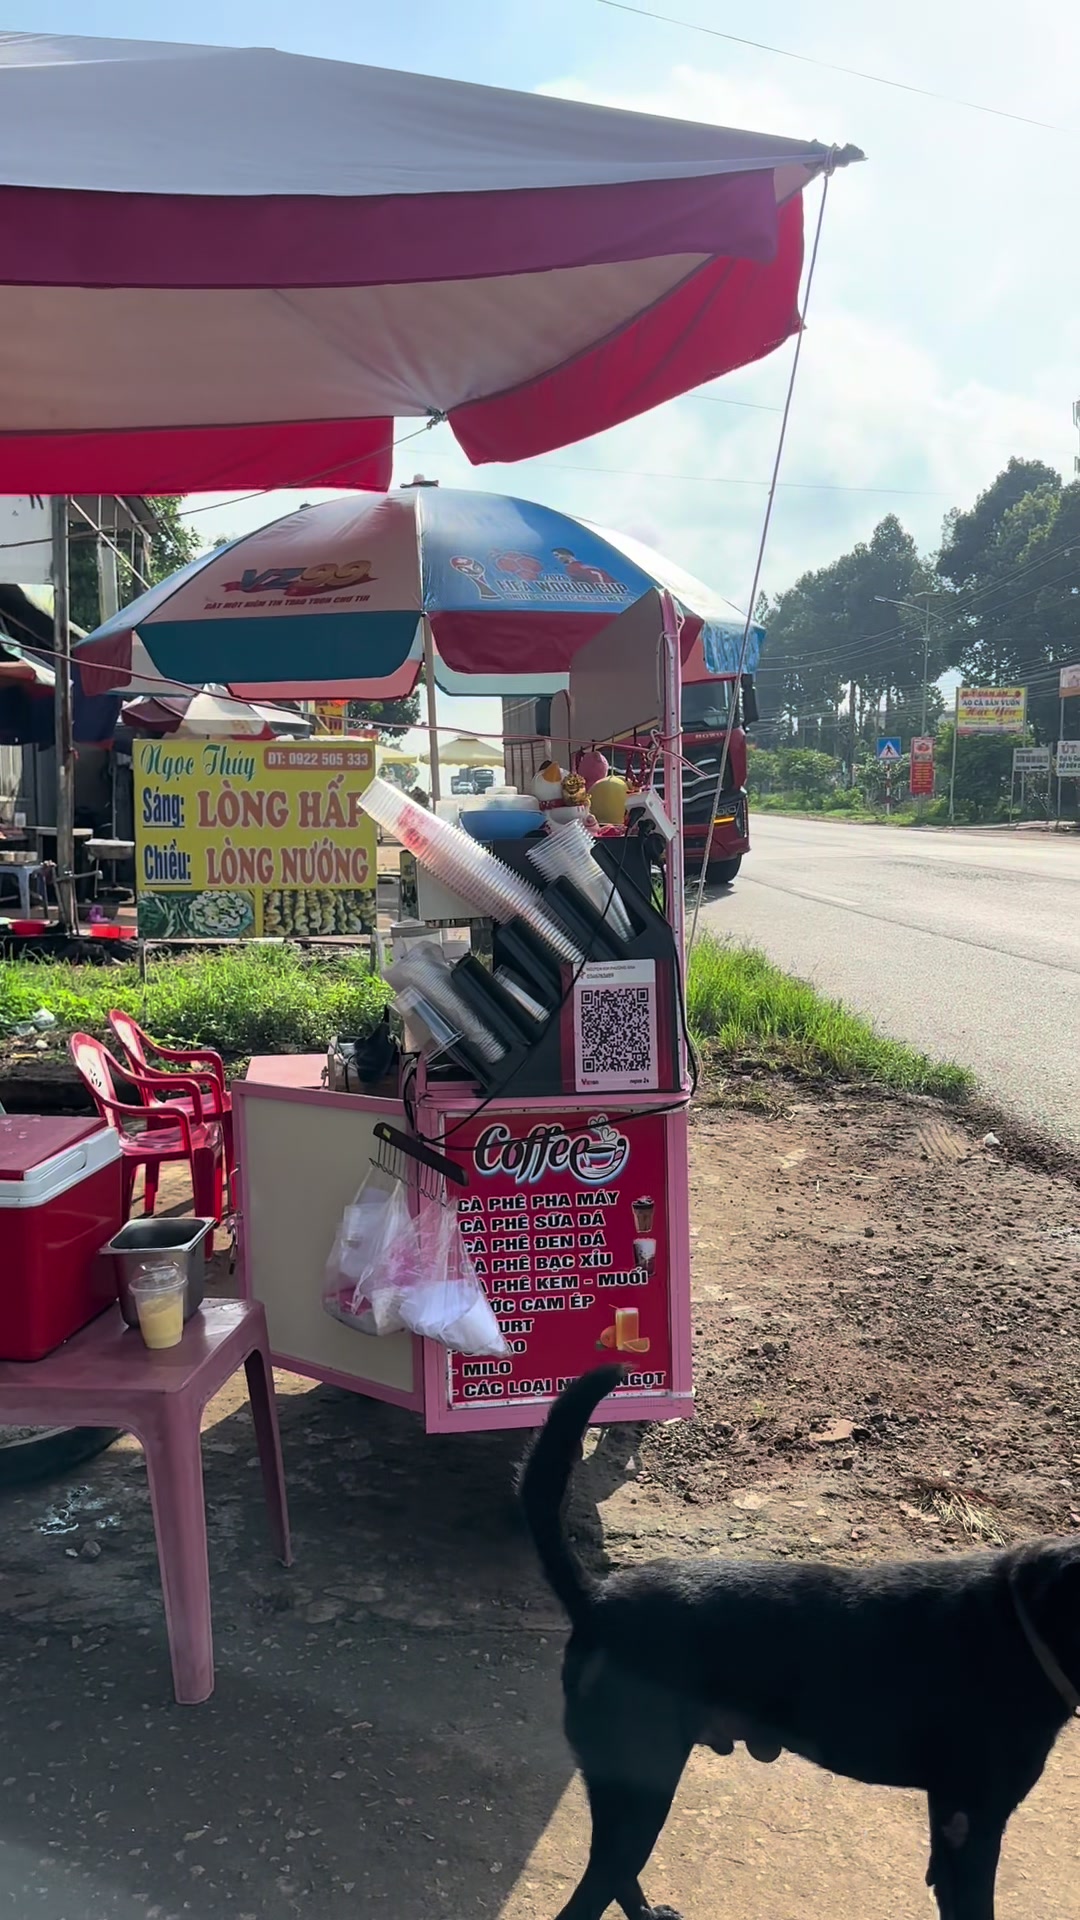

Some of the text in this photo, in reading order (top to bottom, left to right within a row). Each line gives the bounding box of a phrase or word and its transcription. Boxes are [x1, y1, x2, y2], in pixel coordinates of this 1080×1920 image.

[240, 560, 372, 590] VZ99
[535, 581, 594, 595] WORLD
[594, 583, 628, 594] CUP
[140, 743, 256, 781] Ngọc Thúy
[268, 752, 369, 765] ĐT: 0922 505 333
[143, 787, 185, 827] Sáng:
[197, 779, 290, 829] LÒNG
[298, 773, 366, 829] HẤP
[144, 836, 370, 886] Chiều: LÒNG NƯỚNG
[474, 1121, 629, 1185] Coffee
[458, 1189, 619, 1213] CÀ PHÊ PHA MÁY
[460, 1210, 606, 1233] CÀ PHÊ SỮA ĐÁ
[491, 1234, 529, 1251] PHÊ
[535, 1234, 573, 1250] ĐEN
[579, 1230, 606, 1247] ĐÁ
[492, 1254, 530, 1272] PHÊ
[536, 1254, 575, 1272] BẠC
[580, 1250, 613, 1266] XỈU
[492, 1275, 530, 1293] PHÊ
[536, 1275, 579, 1290] KEM
[598, 1266, 648, 1287] MUỐI
[487, 1292, 595, 1315] ỚC CAM ÉP
[498, 1318, 534, 1334] URT
[463, 1361, 512, 1377] MILO
[464, 1379, 503, 1398] CÁC
[508, 1377, 552, 1396] LOẠI
